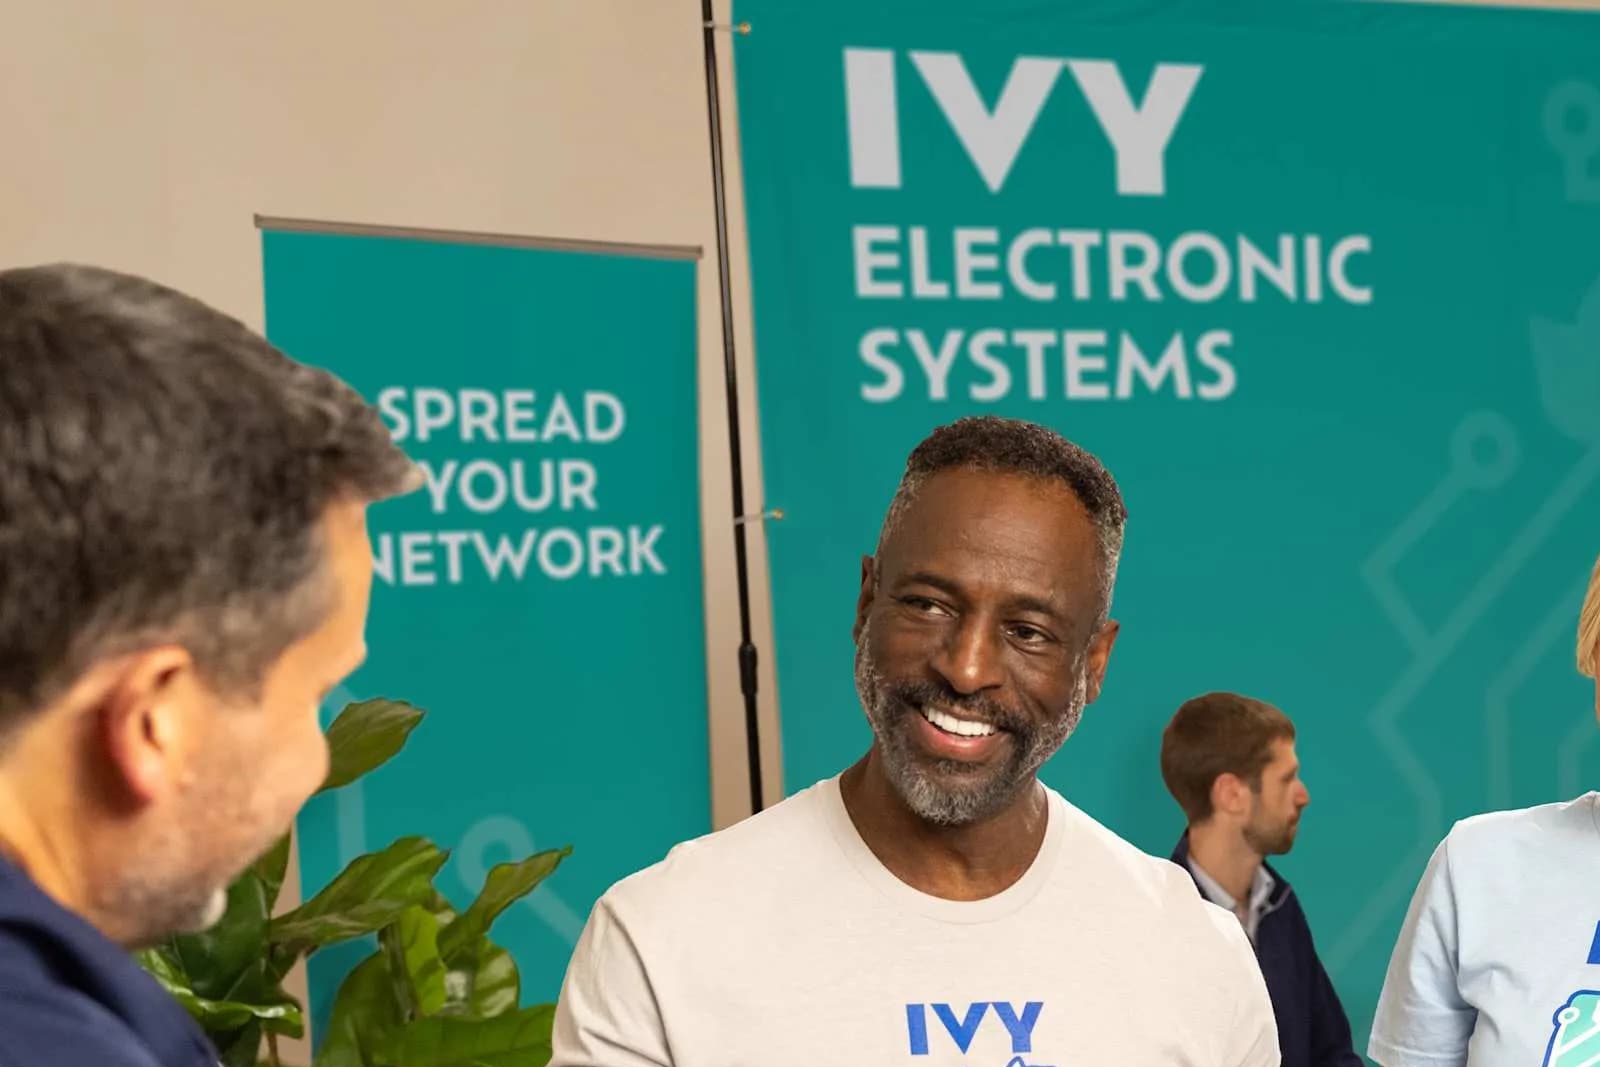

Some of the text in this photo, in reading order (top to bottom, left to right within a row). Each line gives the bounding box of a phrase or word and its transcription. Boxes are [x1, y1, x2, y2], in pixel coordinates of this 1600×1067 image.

[843, 47, 1204, 195] IVY
[852, 224, 1373, 303] ELECTRONIC
[859, 328, 1237, 402] SYSTEMS
[378, 387, 626, 443] SPREAD
[418, 459, 597, 513] YOUR
[905, 1002, 1044, 1055] IVY
